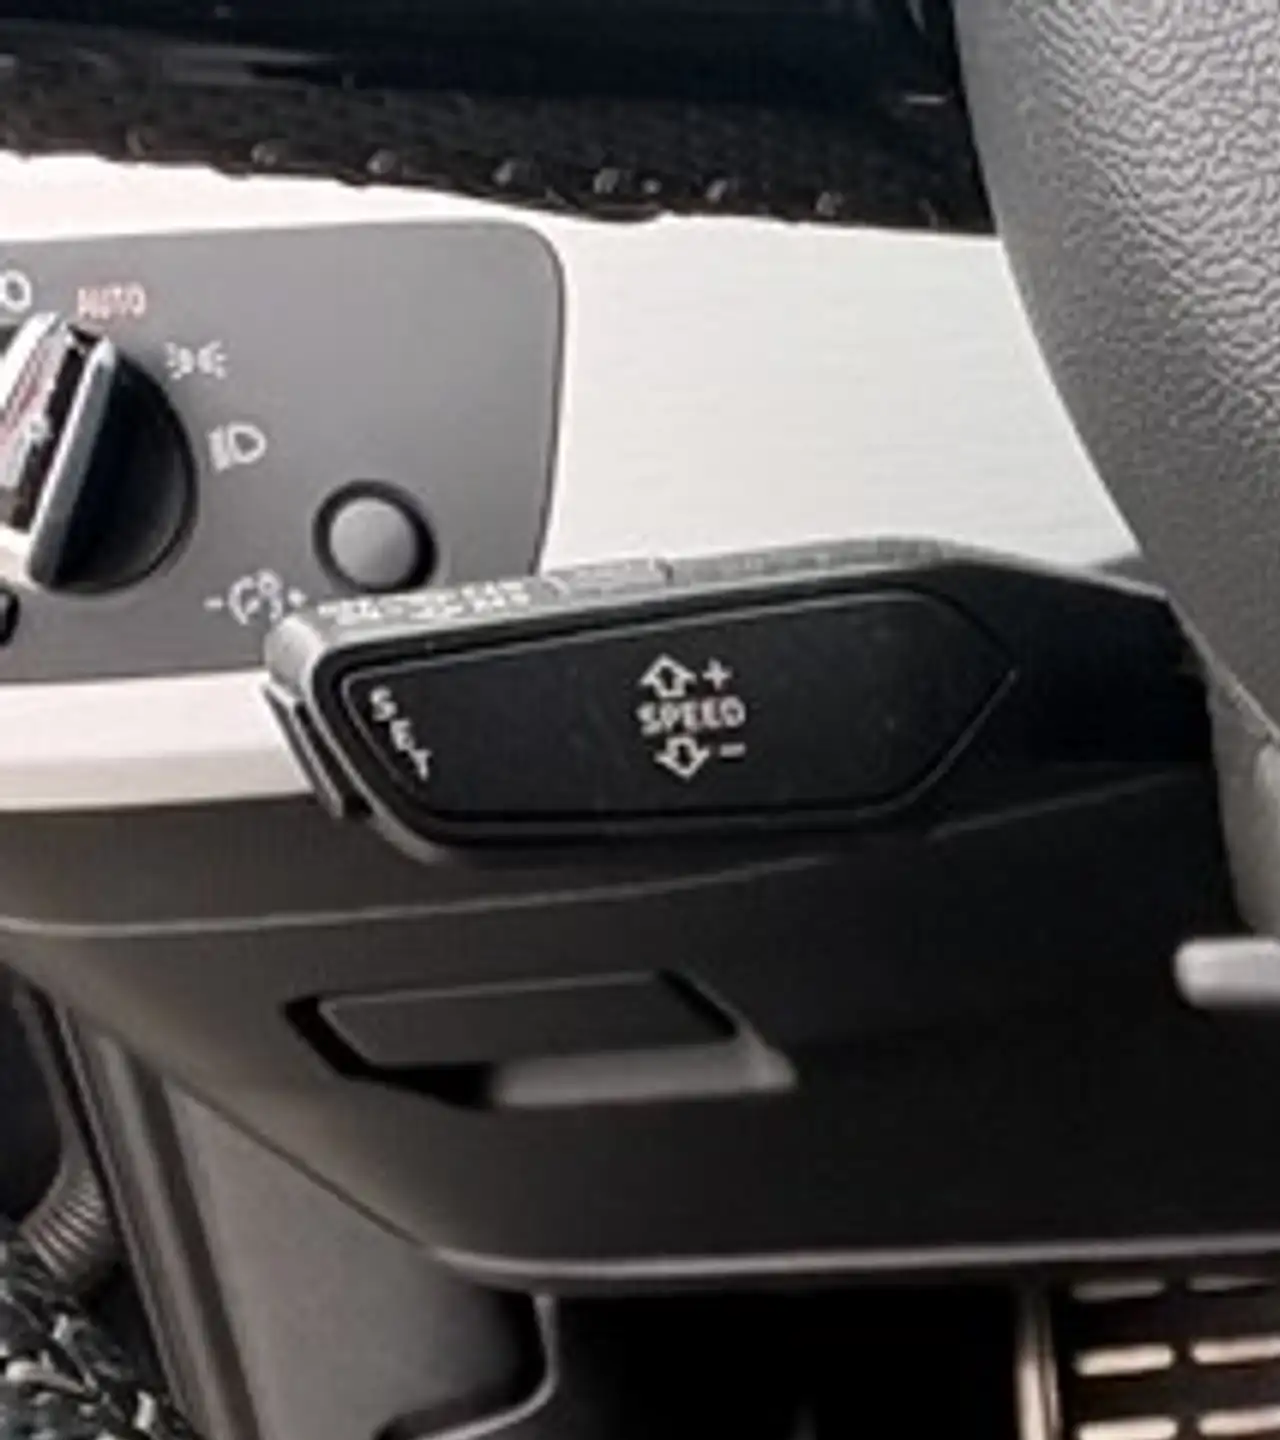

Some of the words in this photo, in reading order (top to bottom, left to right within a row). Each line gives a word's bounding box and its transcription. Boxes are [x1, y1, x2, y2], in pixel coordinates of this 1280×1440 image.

[77, 281, 147, 319] AUTO
[370, 686, 433, 780] SET
[637, 695, 746, 734] SPEED
